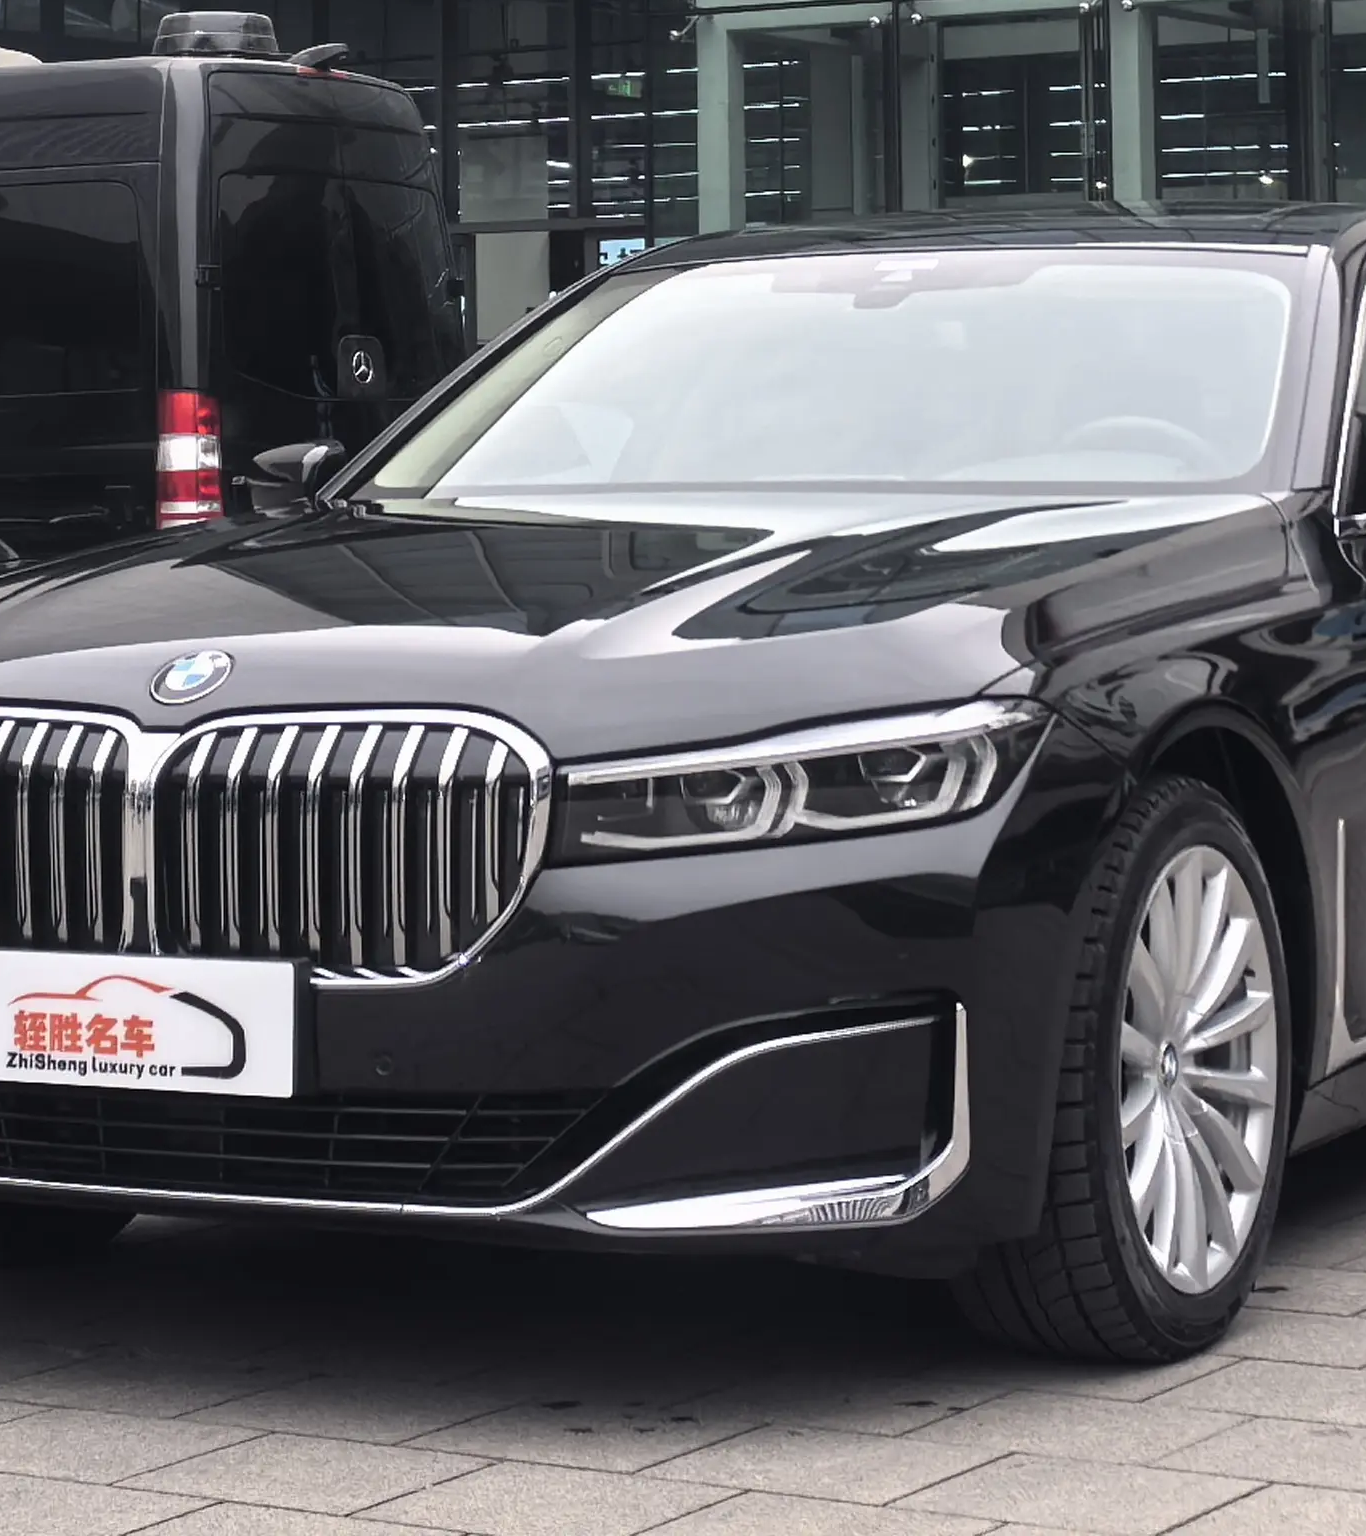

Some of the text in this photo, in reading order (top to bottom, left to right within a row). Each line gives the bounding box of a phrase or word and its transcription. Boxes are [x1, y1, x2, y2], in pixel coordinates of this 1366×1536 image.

[6, 1051, 176, 1080] ZhiSheng luxury car
